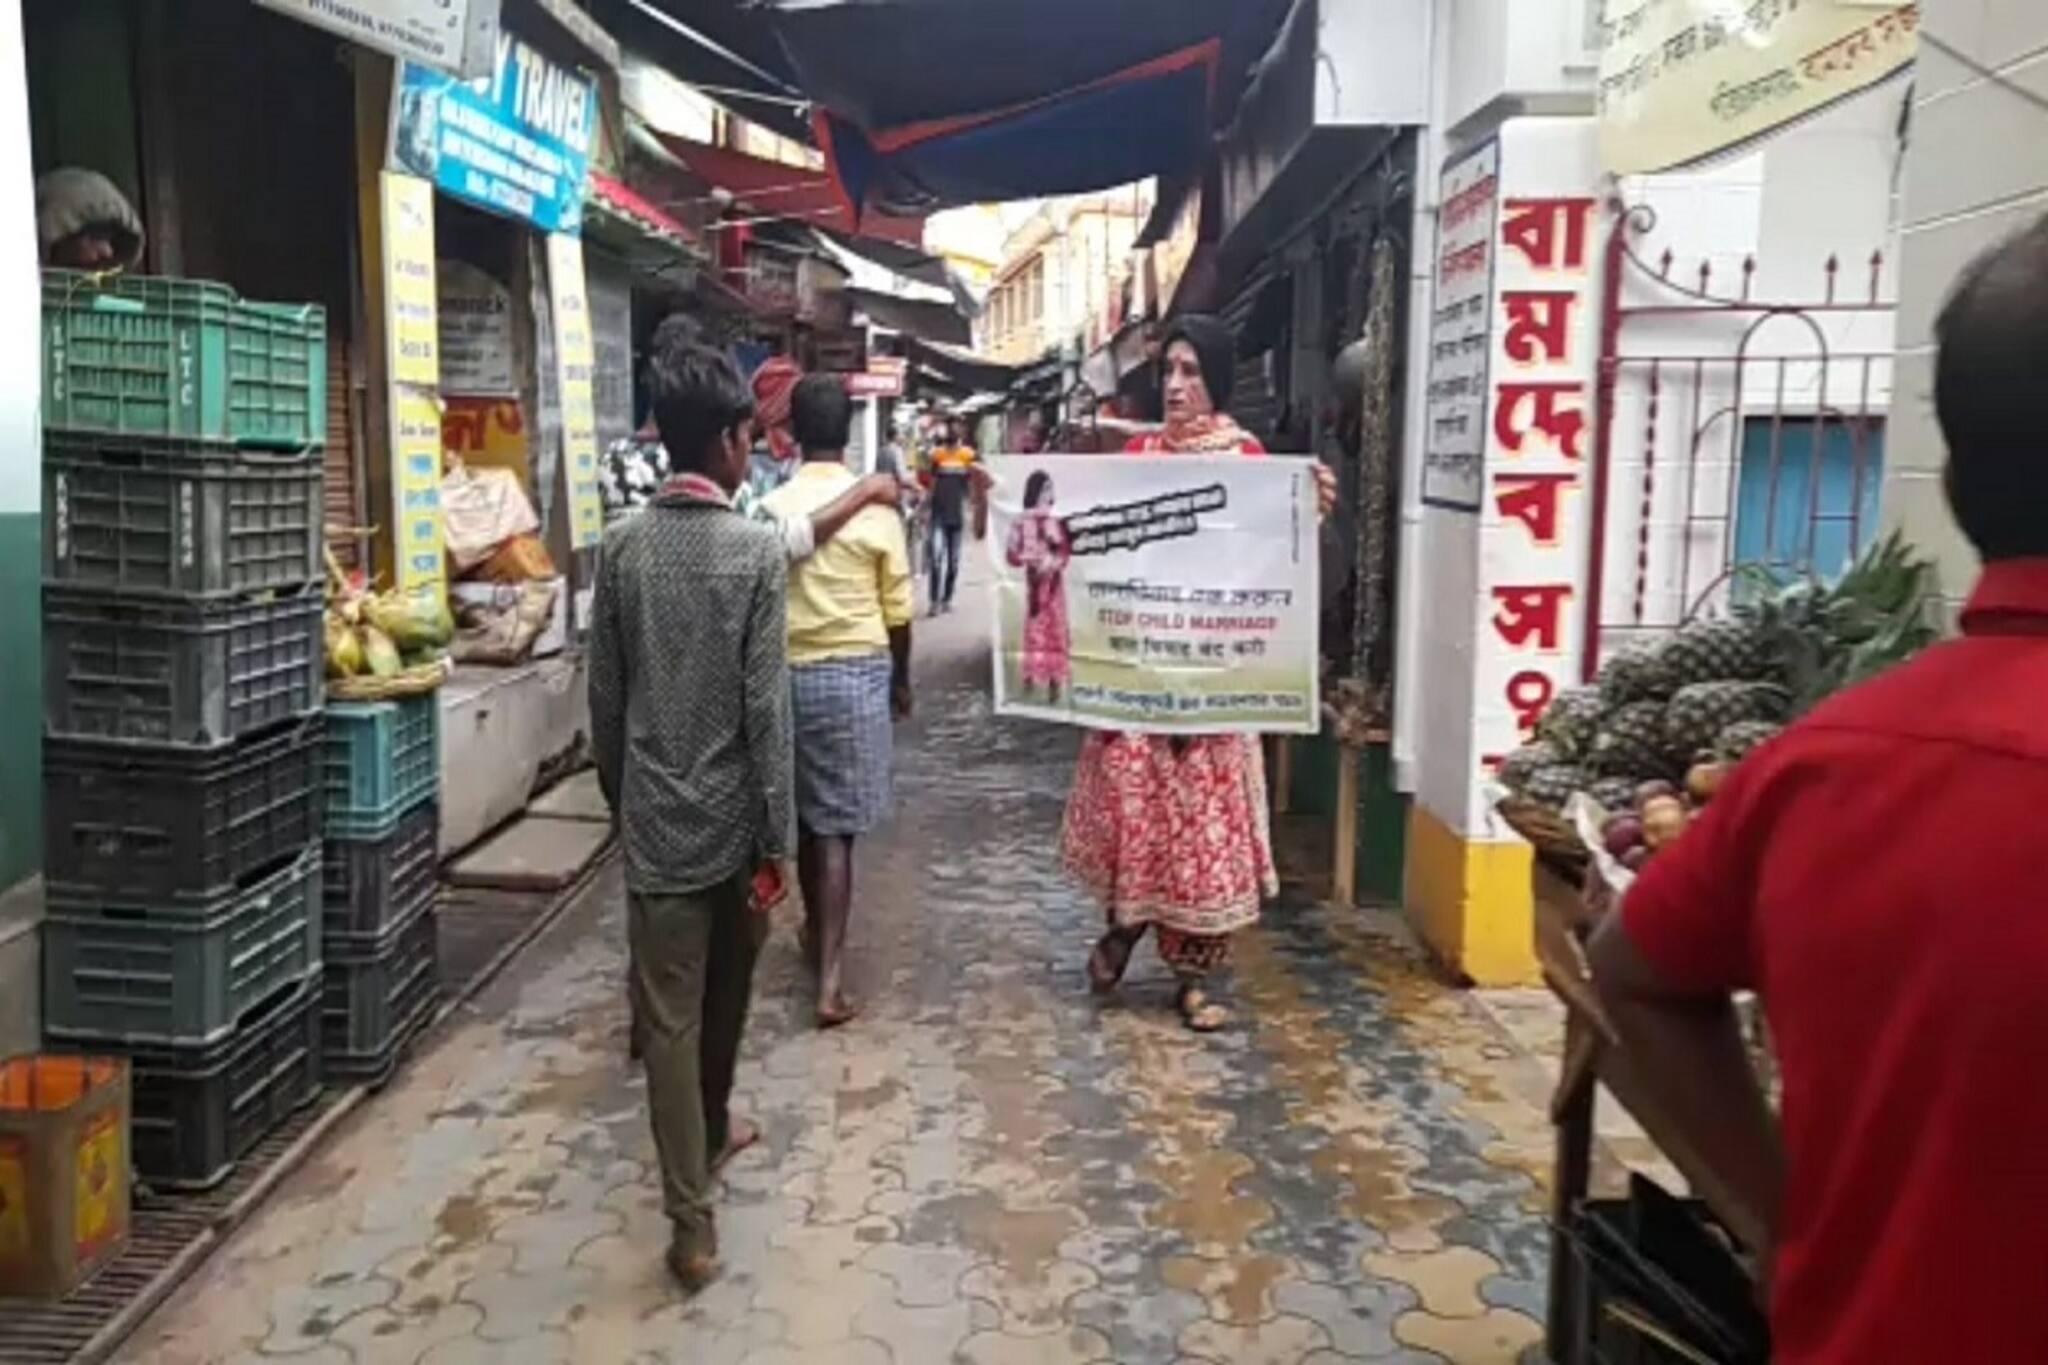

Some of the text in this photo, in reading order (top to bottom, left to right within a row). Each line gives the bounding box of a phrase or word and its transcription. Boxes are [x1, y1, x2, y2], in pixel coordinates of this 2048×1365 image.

[1098, 608, 1132, 627] STOP
[1138, 612, 1184, 629] CHILD
[1482, 585, 1574, 772] সং
